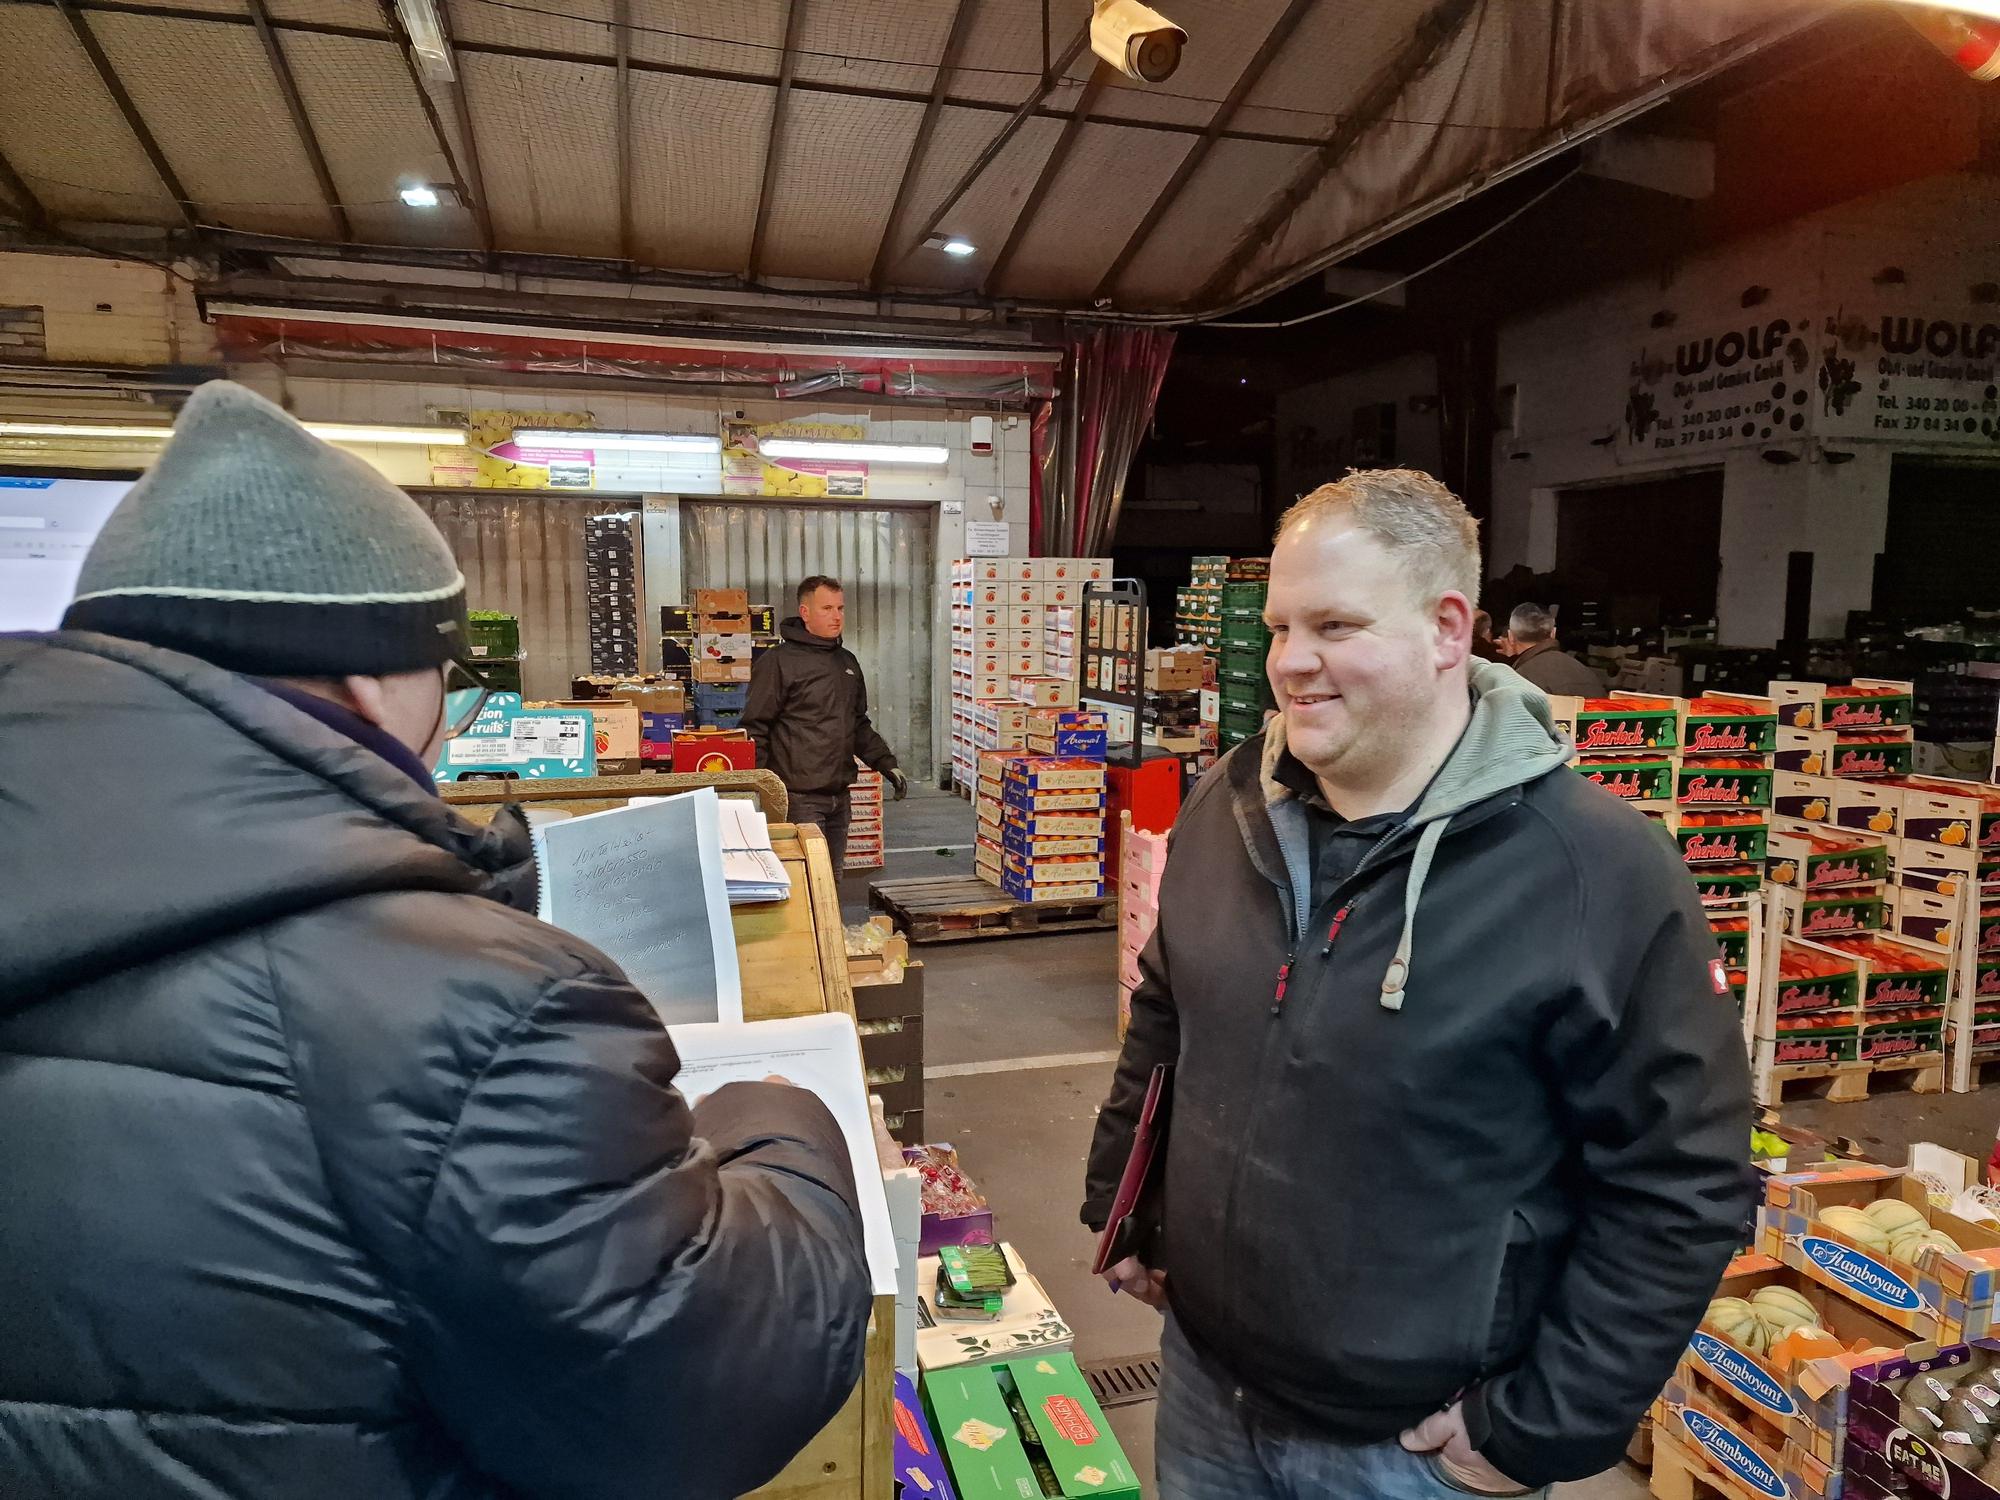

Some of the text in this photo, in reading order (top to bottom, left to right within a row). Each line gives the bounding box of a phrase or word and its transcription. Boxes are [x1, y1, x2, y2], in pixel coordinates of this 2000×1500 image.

[1676, 318, 1790, 376] WOLF
[1706, 409, 1721, 423] 20
[1934, 397, 1949, 412] 20
[1874, 414, 1899, 429] Fax
[1904, 416, 1920, 430] 37
[1944, 418, 1960, 432] 34
[1655, 437, 1676, 449] Fax
[470, 720, 504, 735] Fruits
[1822, 703, 1883, 730] Sherlock
[1575, 718, 1645, 750] Sherlock
[1685, 723, 1747, 752] Sherlock
[1833, 751, 1886, 776] Sherlock
[1677, 775, 1740, 804] Sherlock
[1682, 833, 1737, 862] Sherlock
[1807, 859, 1860, 888] Sherlock
[1802, 907, 1855, 935] Sherlock
[1778, 985, 1831, 1014] Sherlock
[1865, 979, 1922, 1008] Sherlock
[1825, 1244, 1908, 1300] Flamboyant
[1708, 1339, 1783, 1404] Flamboyant
[1053, 1400, 1089, 1439] BOHNEN
[1703, 1418, 1776, 1487] Flamboyant
[1894, 1444, 1941, 1477] EAT ME
